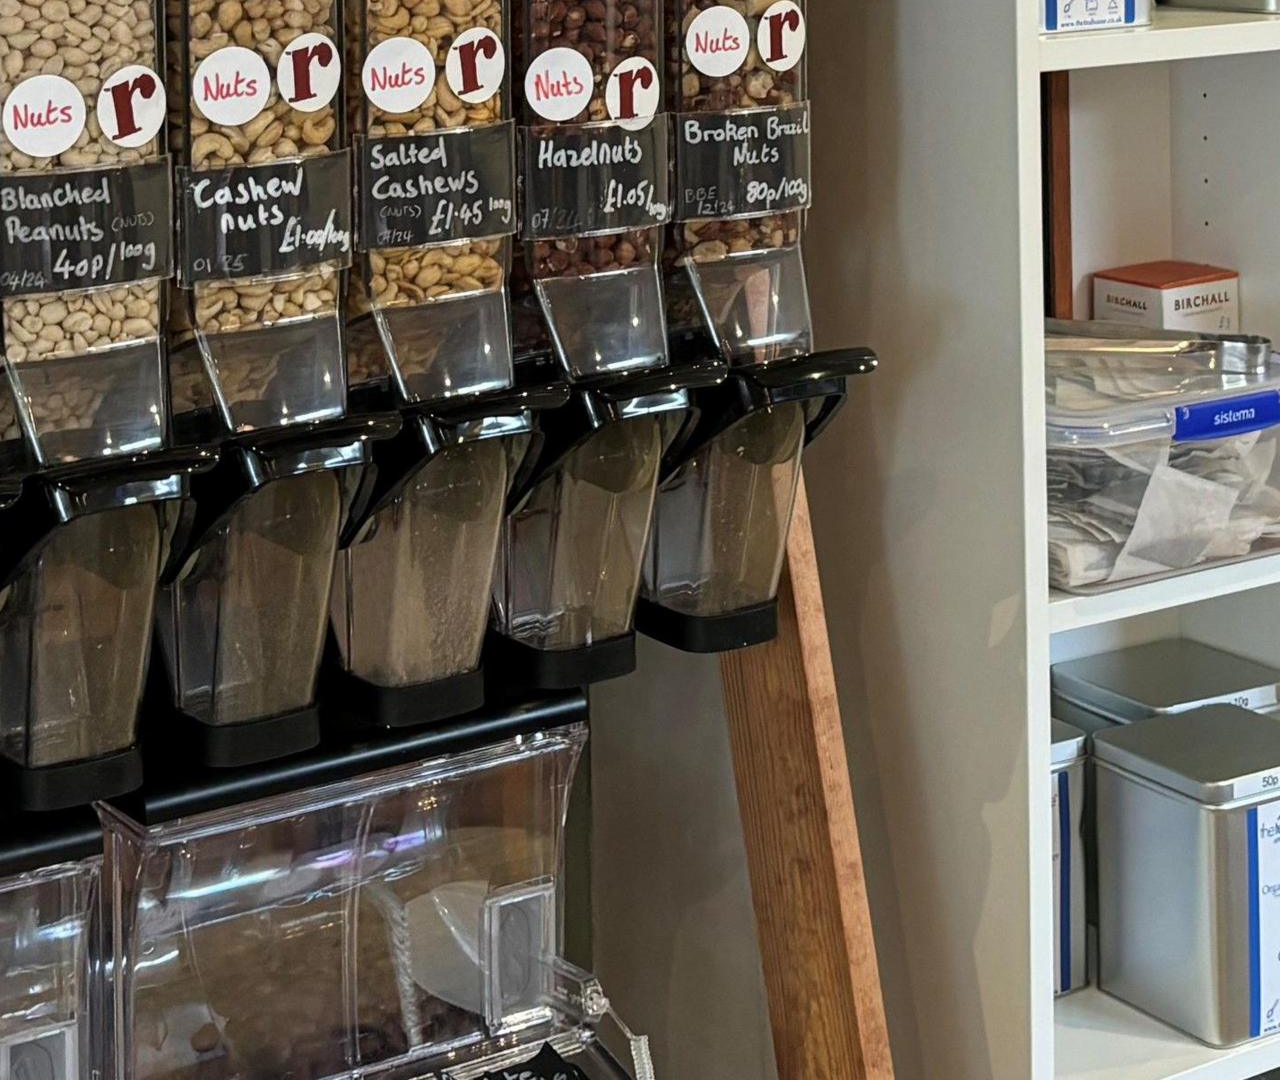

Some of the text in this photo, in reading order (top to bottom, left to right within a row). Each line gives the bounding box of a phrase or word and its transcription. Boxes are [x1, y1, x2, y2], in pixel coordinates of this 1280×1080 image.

[694, 27, 742, 55] Nuts
[763, 9, 801, 64] r
[285, 42, 333, 104] r
[370, 62, 426, 92] Nuts
[452, 35, 497, 96] r
[203, 71, 258, 102] Nuts
[534, 70, 585, 102] Nuts
[613, 66, 654, 120] r
[13, 100, 73, 131] Nuts
[103, 72, 157, 141] r
[684, 110, 811, 145] Broken Brazil
[369, 135, 448, 170] Salted
[537, 135, 644, 169] Hazelnuts
[732, 143, 781, 168] Nuts
[0, 176, 112, 212] Blanched
[192, 167, 305, 210] Cashew
[370, 170, 480, 200] Cashews
[4, 215, 105, 245] Peanuts
[220, 204, 286, 234] nuts
[1173, 291, 1230, 312] BIRCHALL
[1213, 406, 1256, 426] sistema
[1261, 775, 1280, 789] 50p
